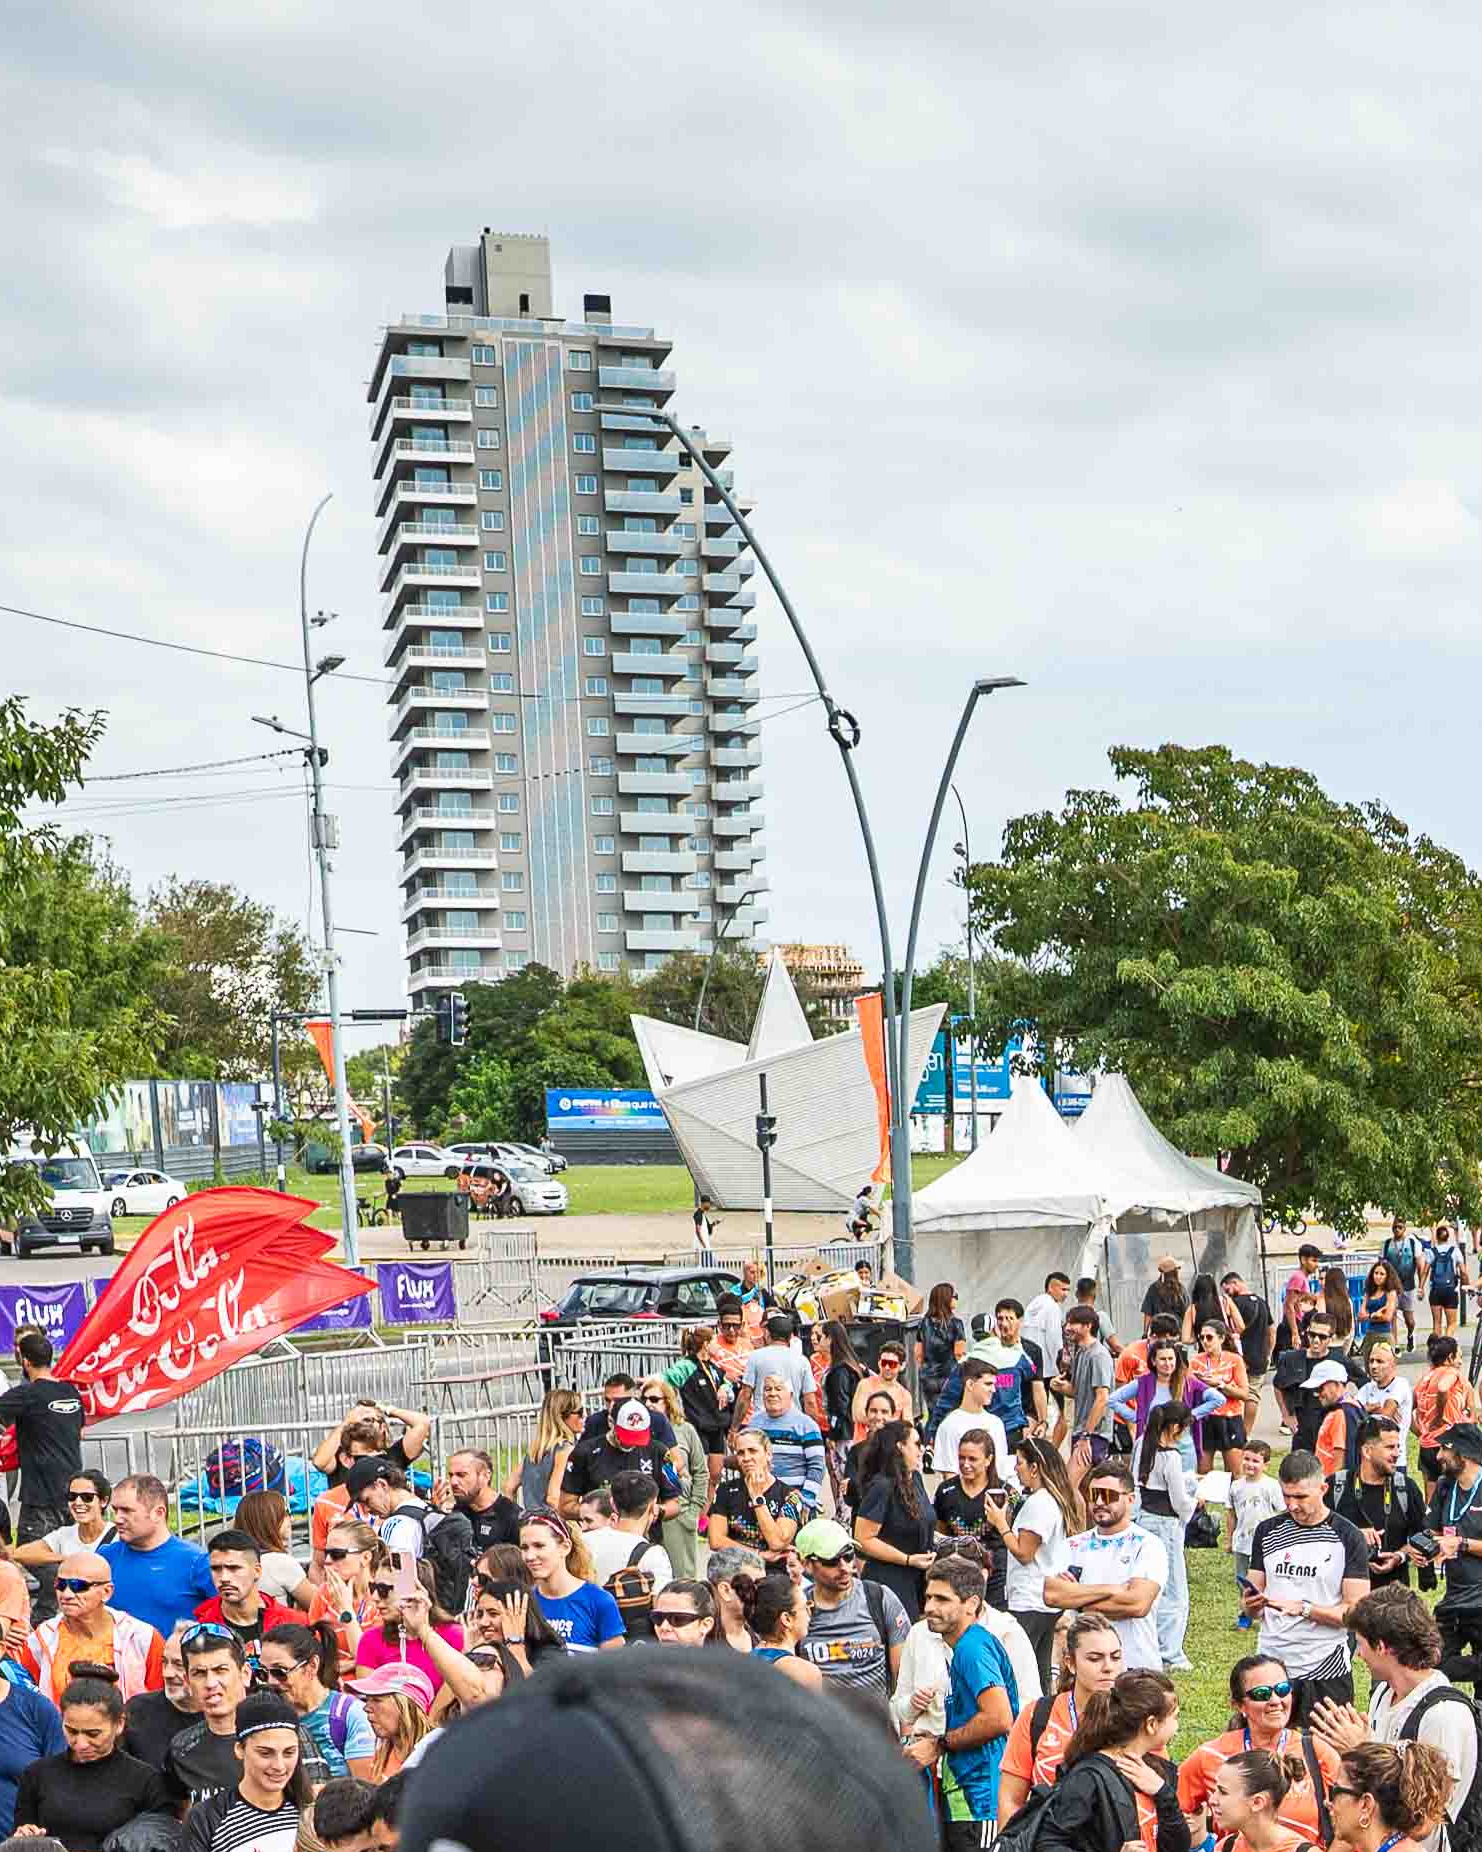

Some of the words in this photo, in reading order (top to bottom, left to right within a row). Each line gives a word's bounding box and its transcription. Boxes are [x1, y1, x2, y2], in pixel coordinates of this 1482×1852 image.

[1275, 1561, 1318, 1578] ATENAS
[805, 1641, 849, 1662] 10K
[850, 1646, 875, 1661] 2024
